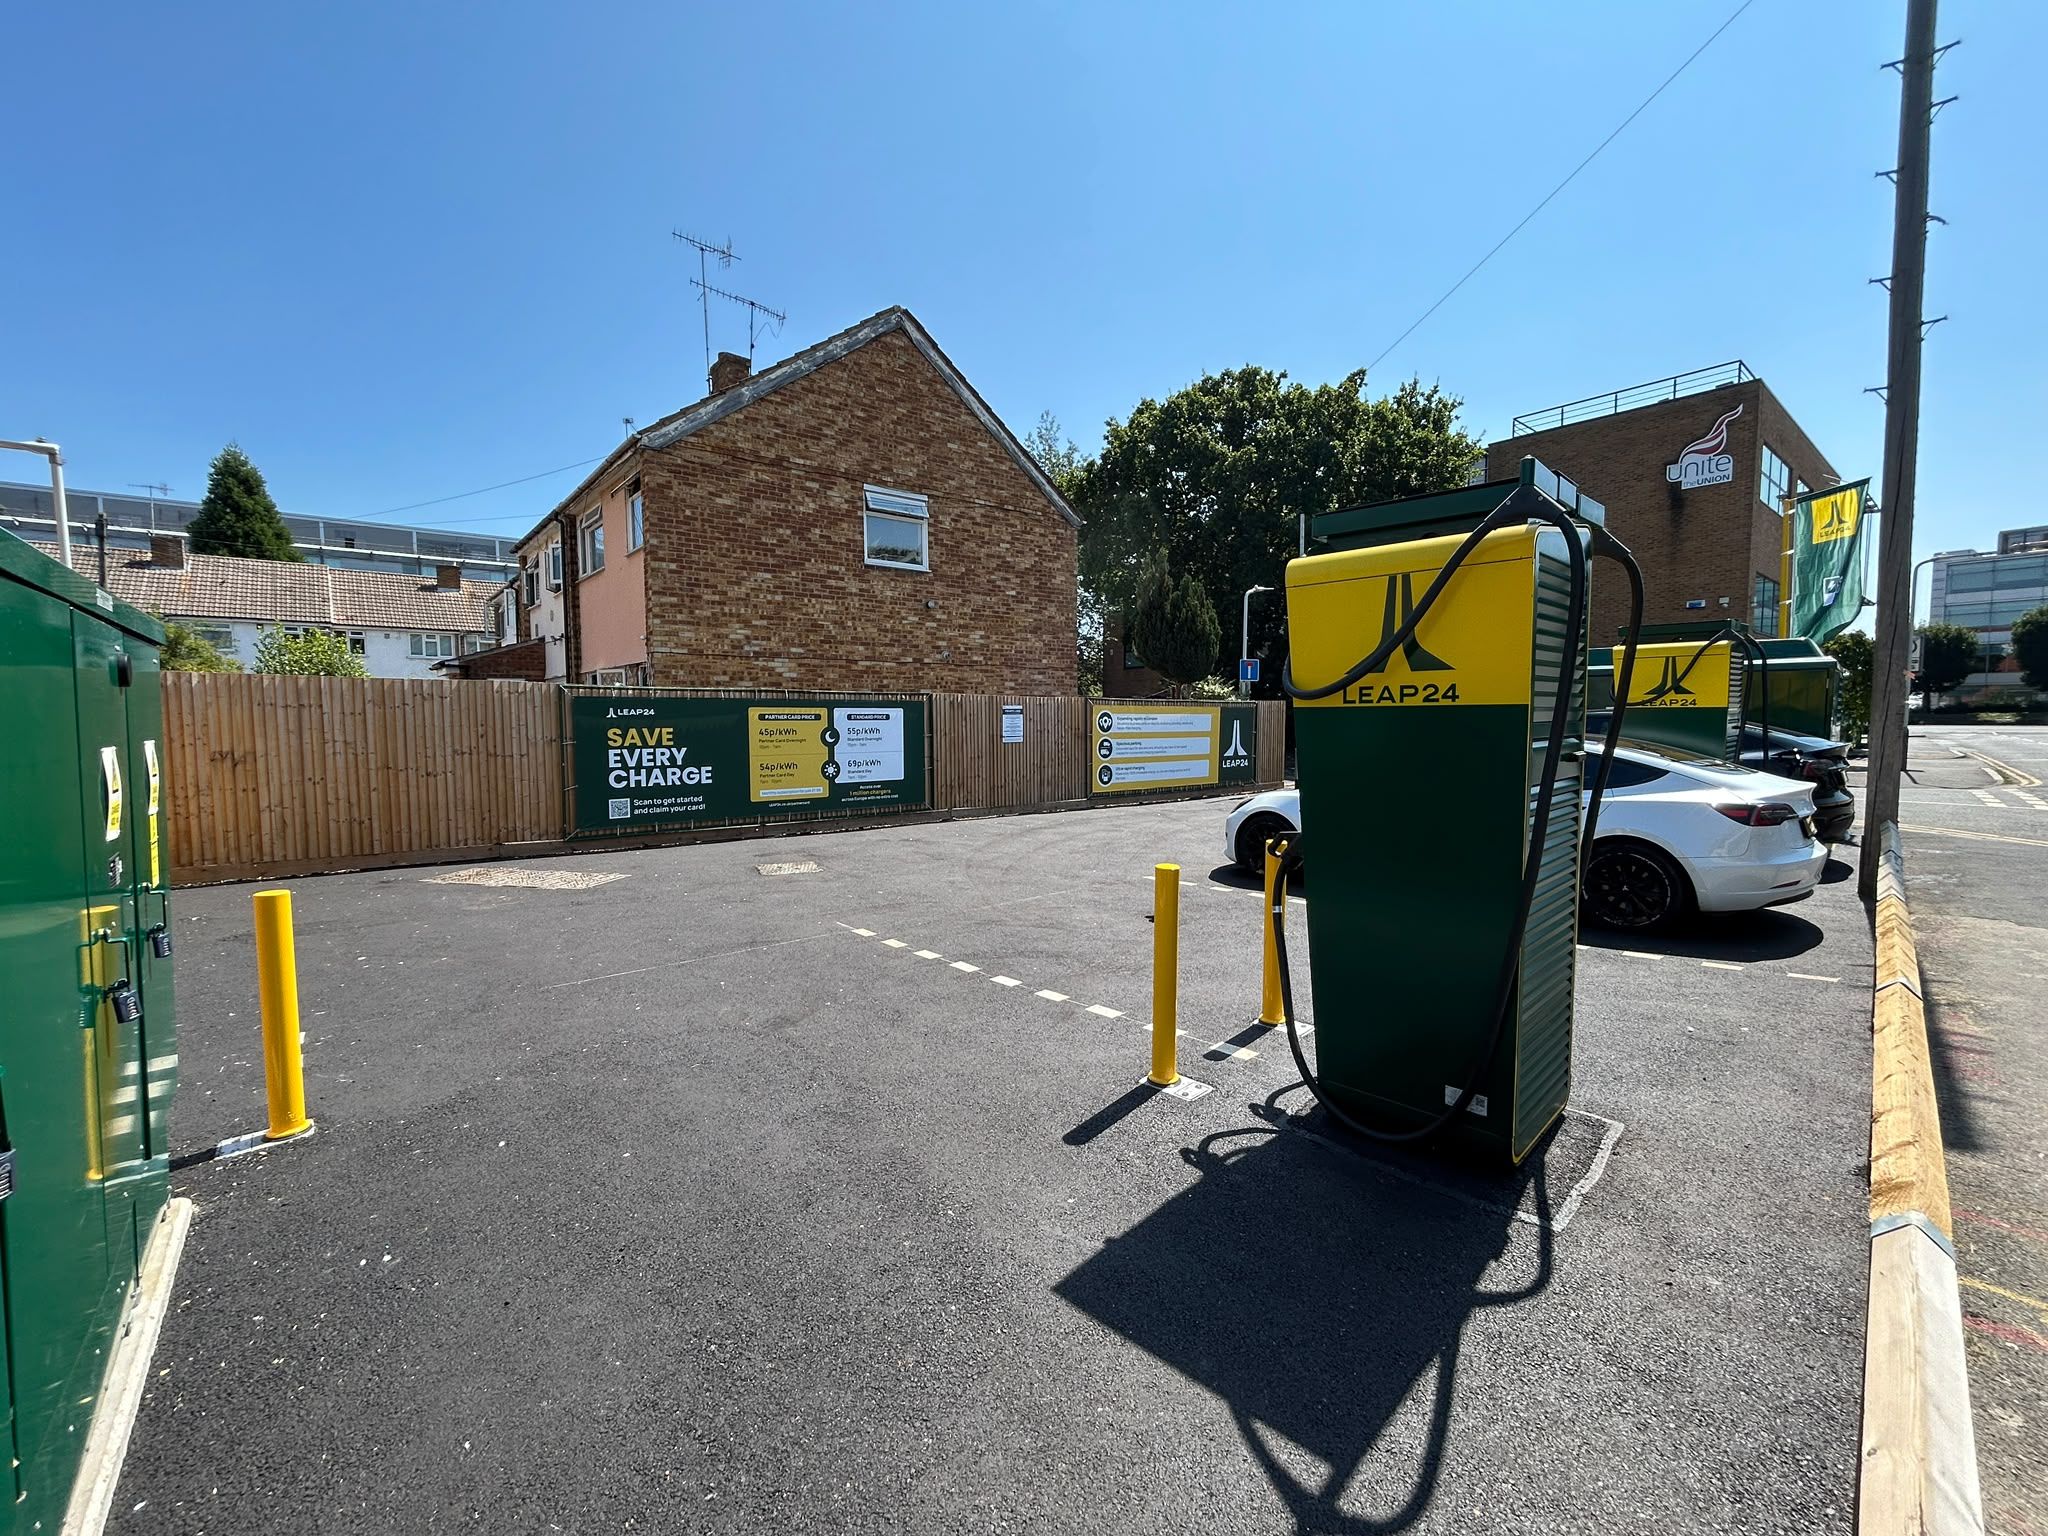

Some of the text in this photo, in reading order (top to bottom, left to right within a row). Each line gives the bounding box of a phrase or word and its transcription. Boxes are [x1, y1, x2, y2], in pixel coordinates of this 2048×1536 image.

[1668, 455, 1731, 481] unite
[1342, 683, 1460, 705] LEAP24
[617, 708, 655, 716] LEAP24
[607, 727, 674, 747] SAVE
[758, 728, 798, 738] 45p/kWh
[847, 727, 881, 736] 55p/kWh
[608, 747, 687, 768] EVERY
[1222, 758, 1249, 768] LEAP24
[759, 762, 798, 772] 54p/kWh
[847, 759, 882, 768] 69p/kWh
[608, 766, 713, 788] CHARGE
[662, 797, 675, 806] get
[676, 795, 703, 803] started
[633, 803, 706, 815] and claim your card!
